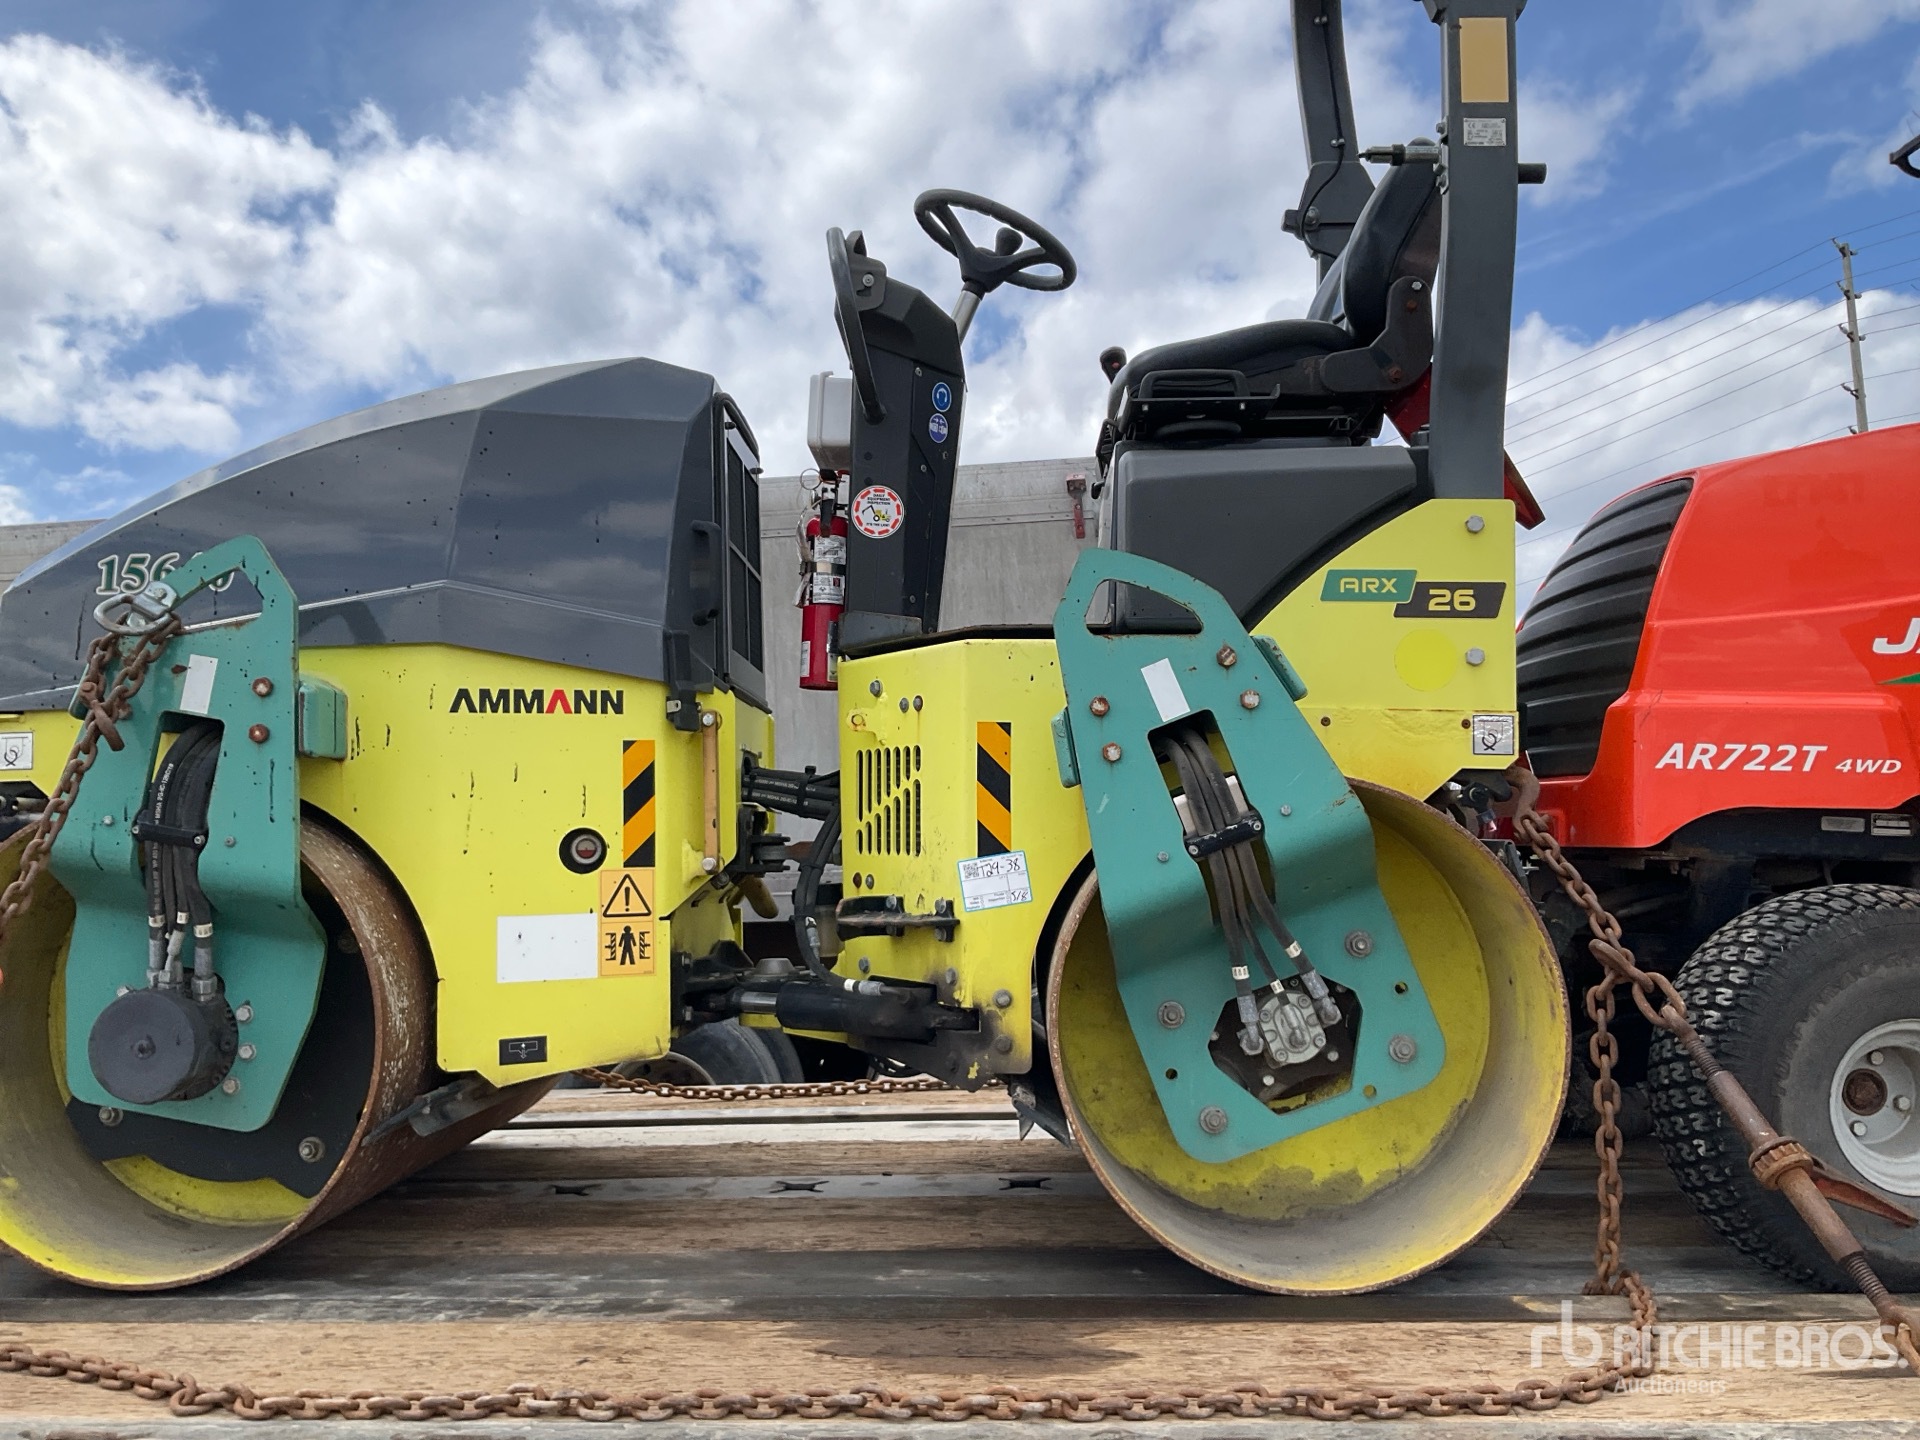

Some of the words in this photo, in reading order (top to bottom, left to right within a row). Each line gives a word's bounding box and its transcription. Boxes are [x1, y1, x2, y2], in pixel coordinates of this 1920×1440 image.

[1339, 577, 1398, 593] ARX
[1428, 588, 1476, 611] 26
[1872, 617, 1920, 654] J
[449, 688, 624, 714] AMMANN
[1655, 743, 1829, 772] AR722T
[1835, 759, 1902, 774] 4WD
